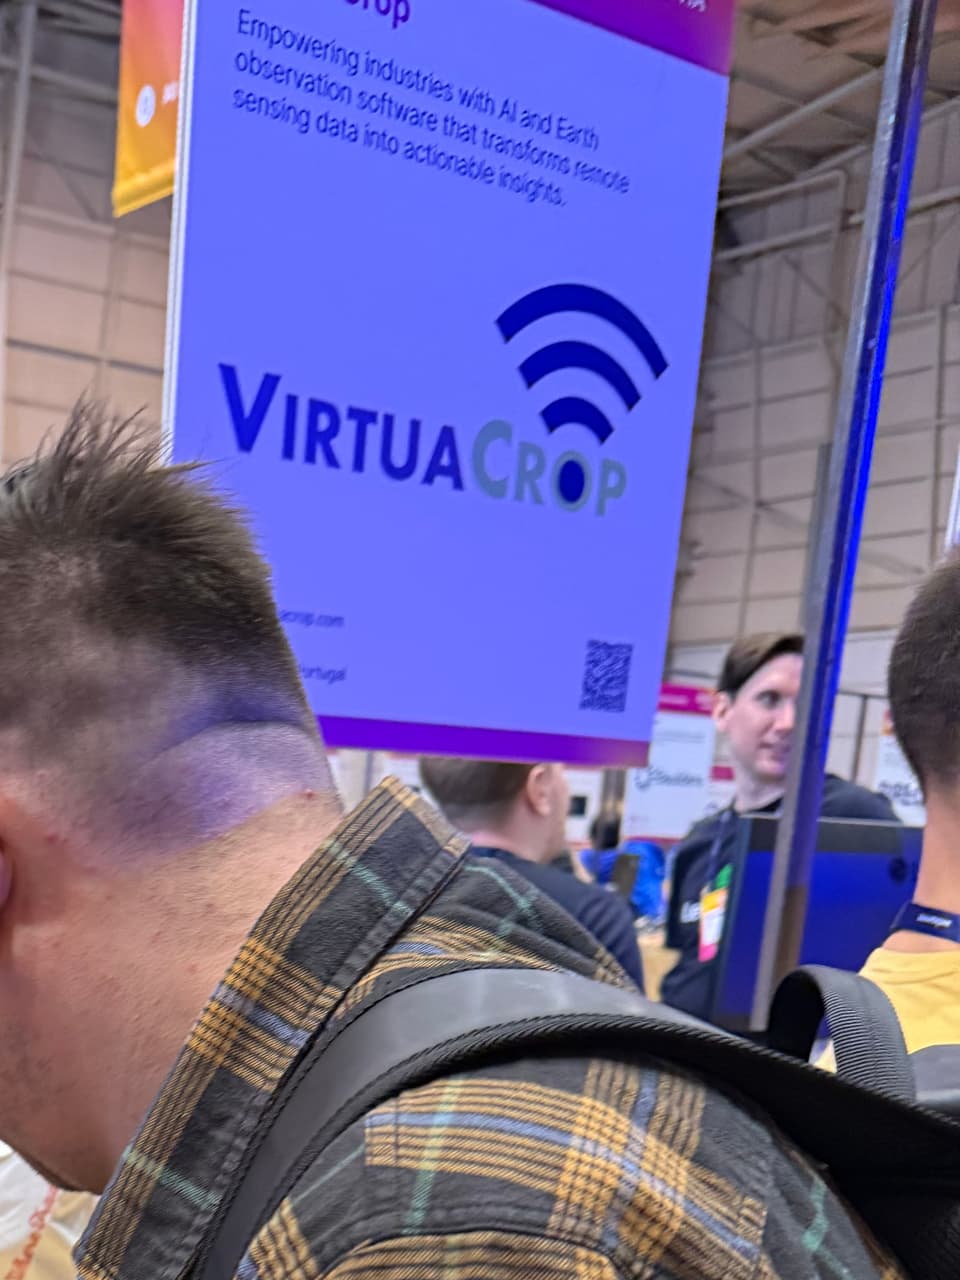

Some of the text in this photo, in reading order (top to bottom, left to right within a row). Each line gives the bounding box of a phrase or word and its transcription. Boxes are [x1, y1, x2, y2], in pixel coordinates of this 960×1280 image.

[232, 88, 567, 207] sensing data into actionable insights.
[234, 50, 630, 194] observation software that transforms remote
[237, 8, 600, 151] Empowering industries with AI and Earth
